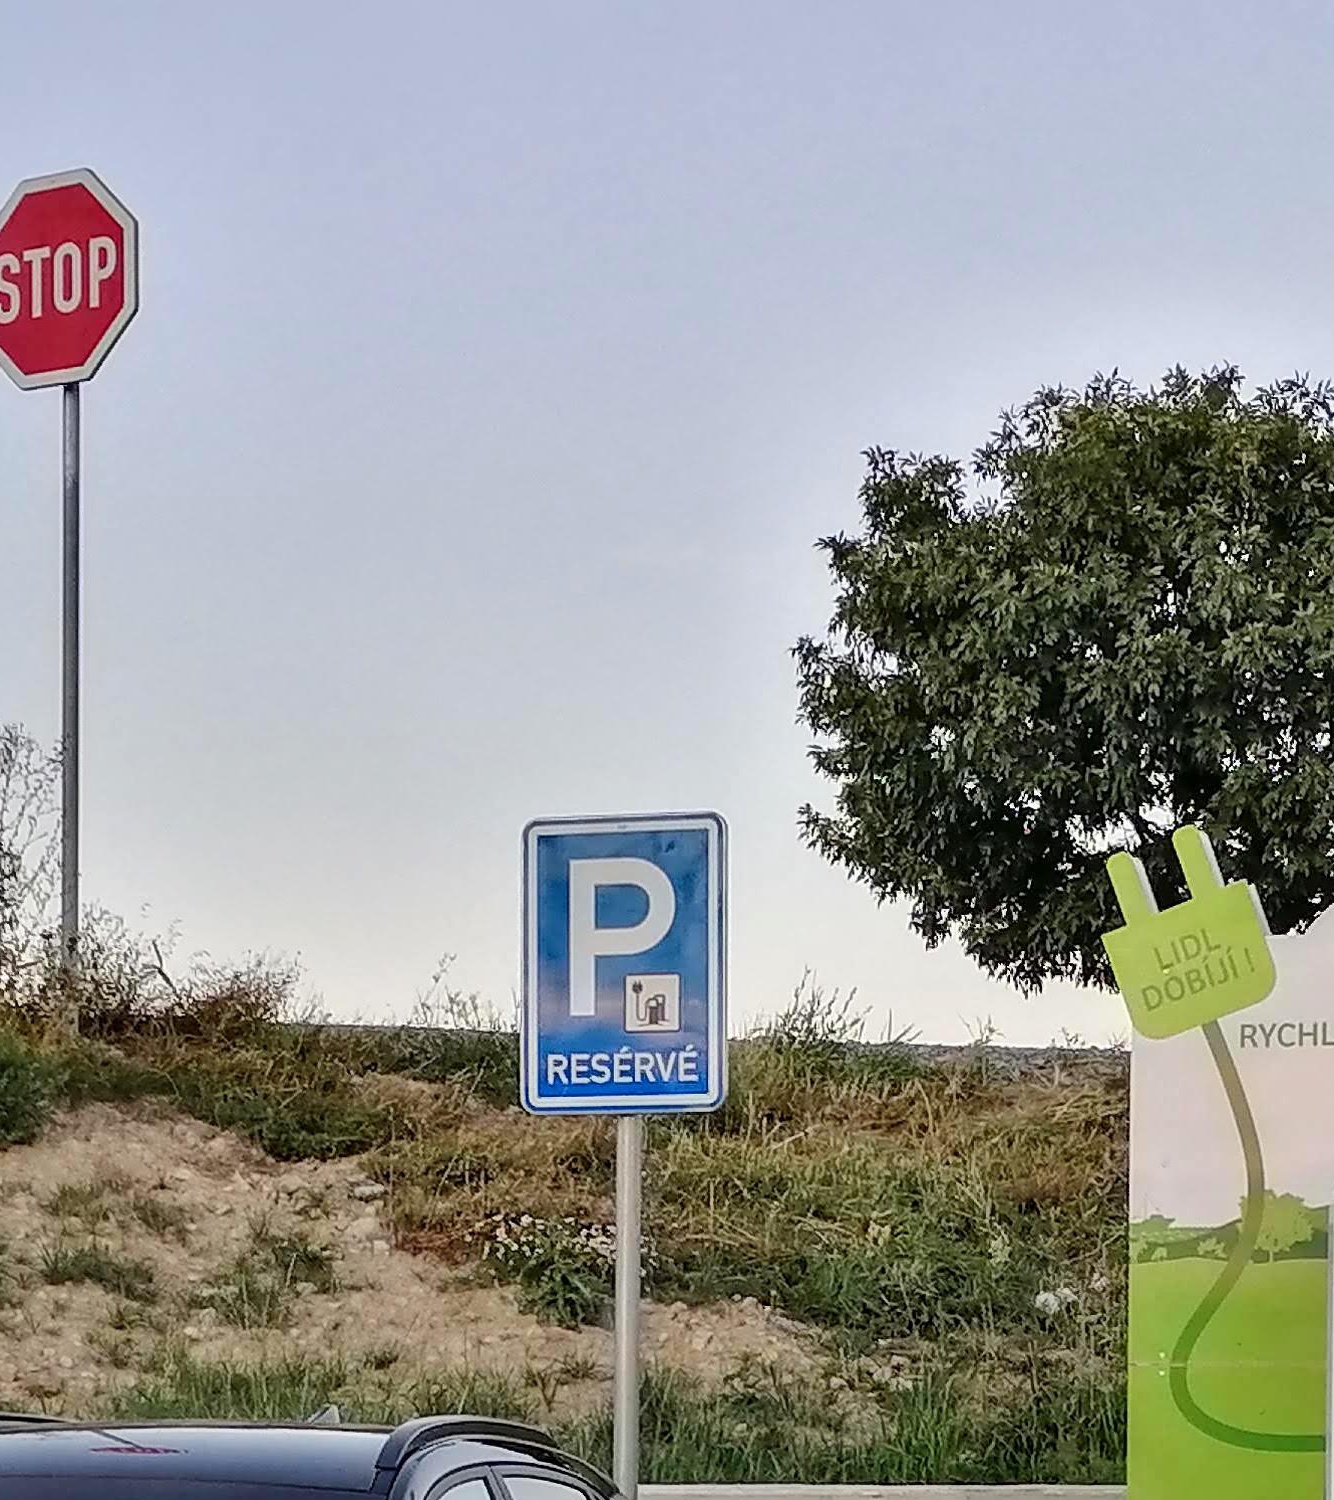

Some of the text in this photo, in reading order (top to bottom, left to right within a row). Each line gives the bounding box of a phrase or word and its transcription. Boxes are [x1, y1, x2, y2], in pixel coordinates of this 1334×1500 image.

[569, 857, 676, 1017] P
[1153, 928, 1221, 971] LIDL
[547, 1045, 699, 1085] RESÉRVÉ
